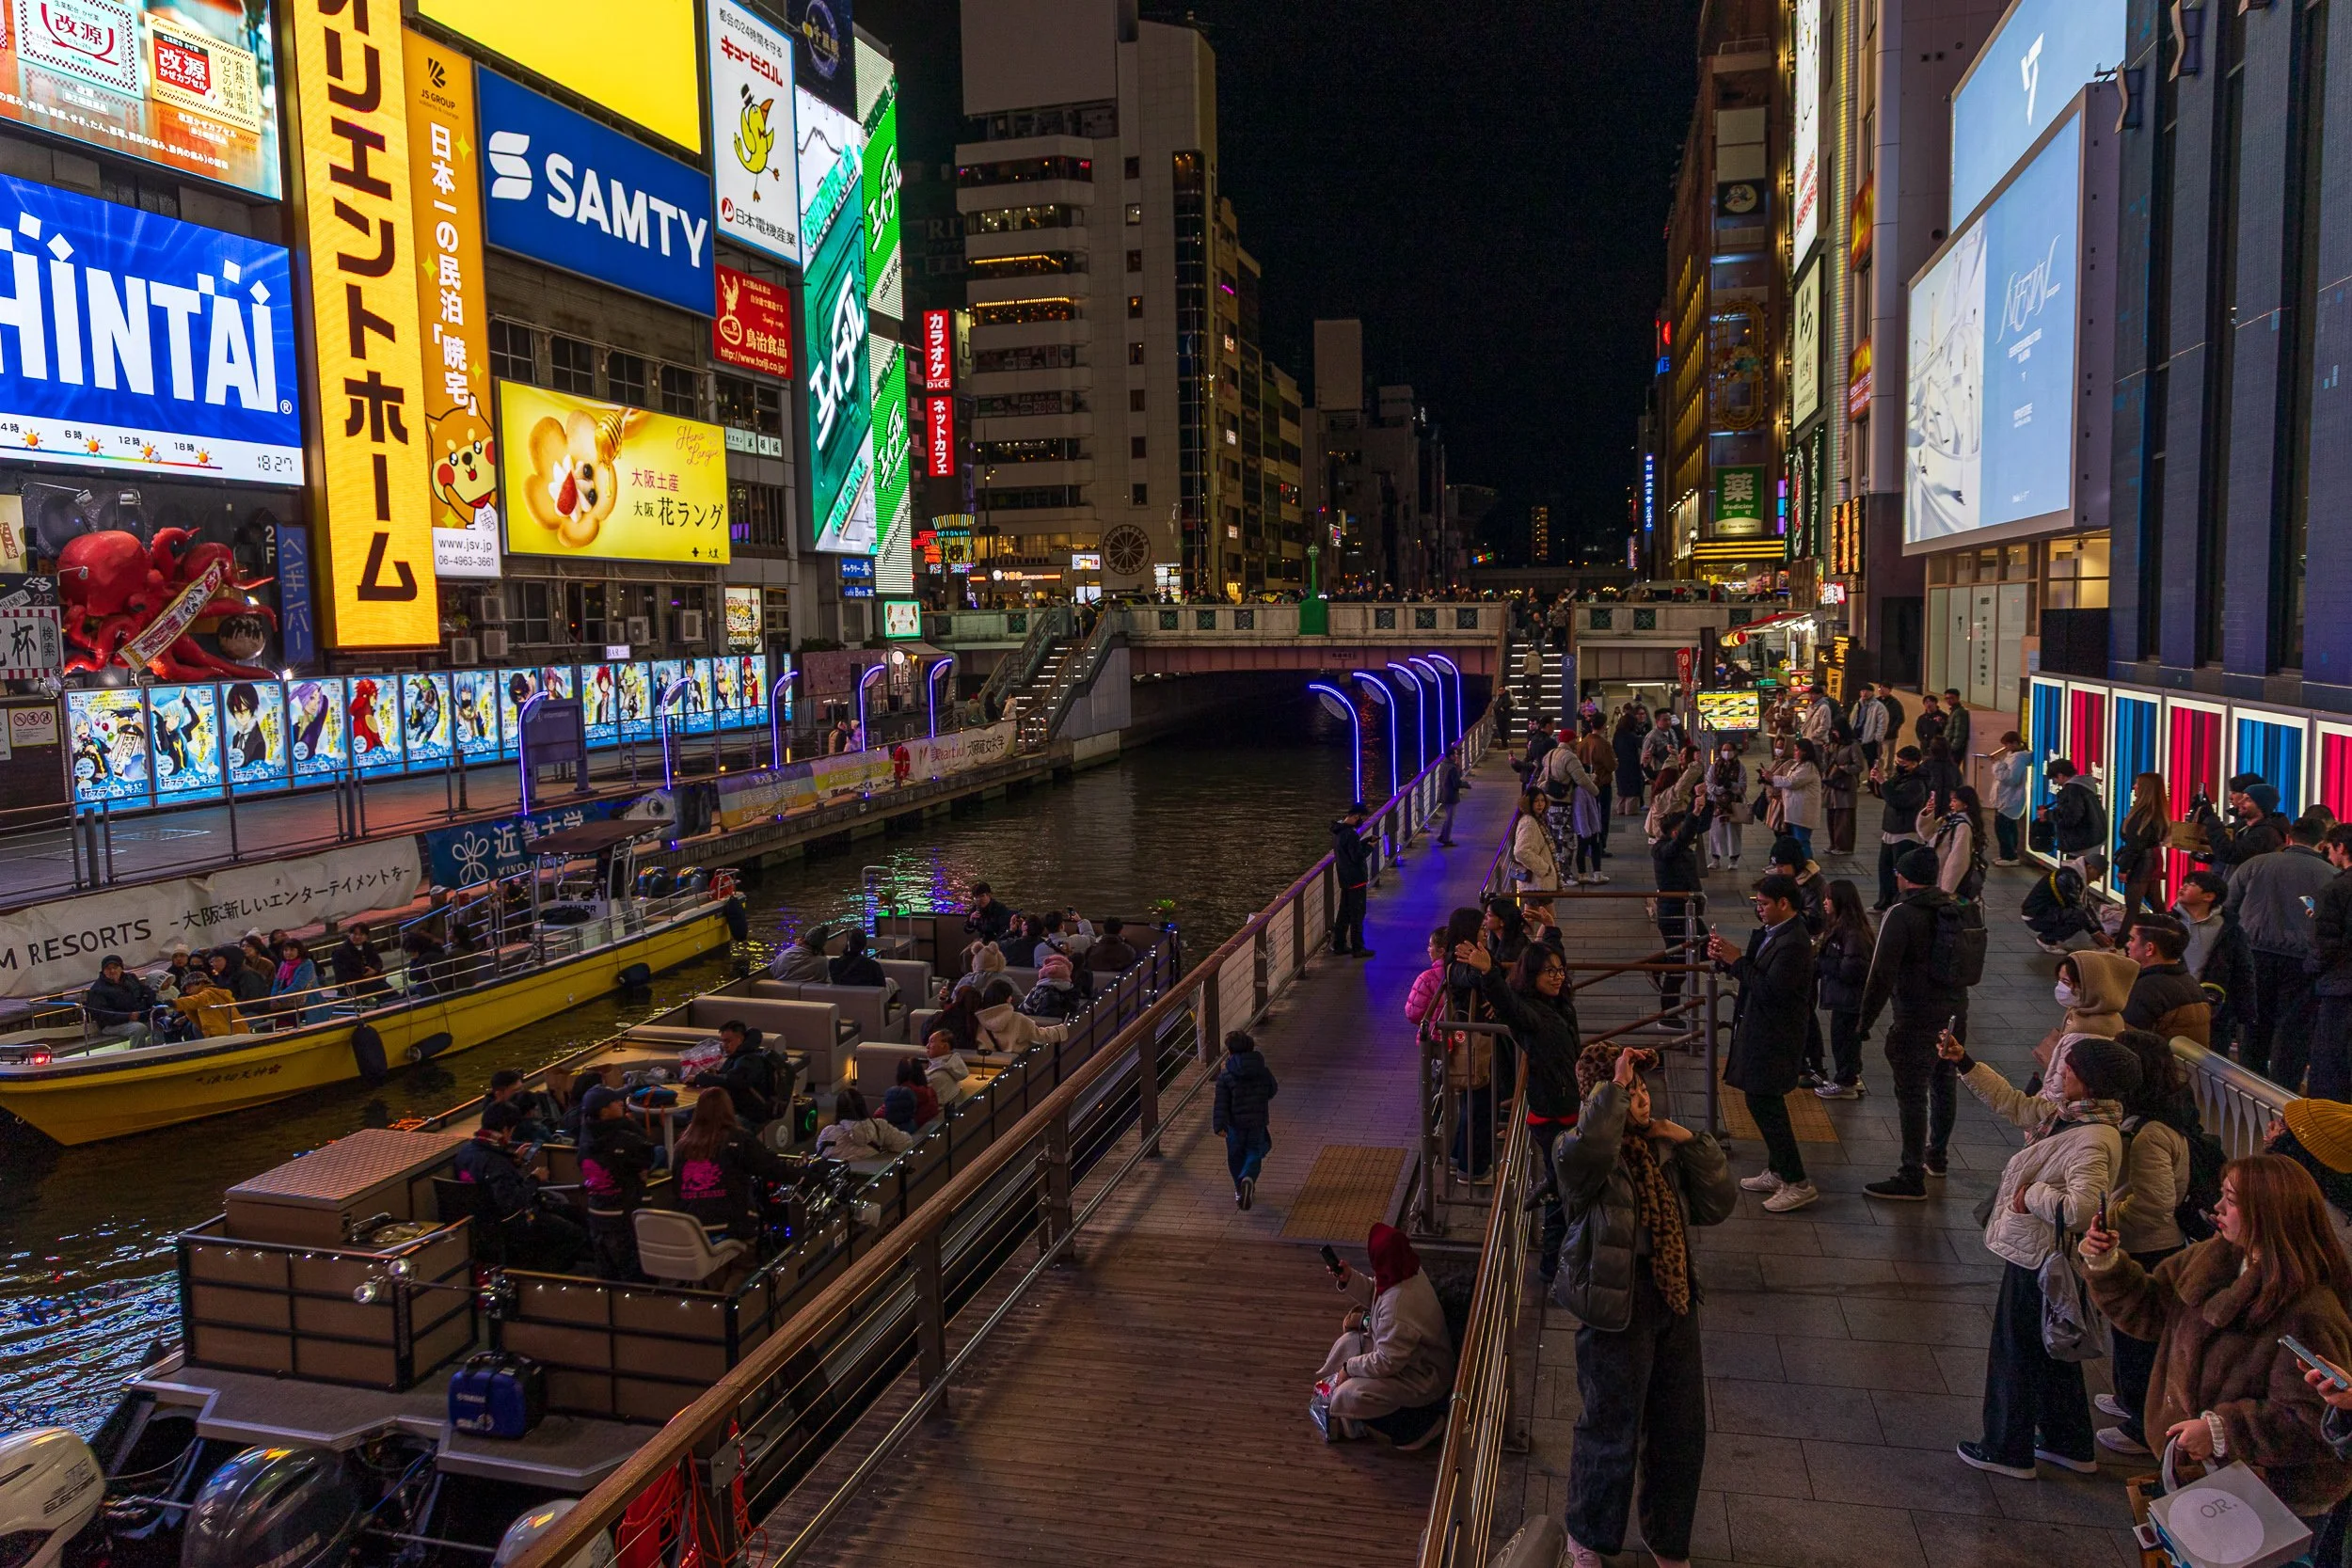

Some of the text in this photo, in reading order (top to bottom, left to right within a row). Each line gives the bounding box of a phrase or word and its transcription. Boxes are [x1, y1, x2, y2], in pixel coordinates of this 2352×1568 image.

[55, 12, 103, 45] 改源
[157, 46, 207, 82] 改源
[721, 35, 783, 87] キュービクル
[160, 67, 208, 91] かぜカプセル
[421, 89, 430, 100] JS
[431, 92, 456, 110] GROUP
[546, 153, 707, 268] SAMTY
[930, 313, 946, 378] カラオケ
[65, 430, 83, 440] 6時
[119, 436, 140, 447] 12時
[174, 441, 195, 452] 18時
[933, 400, 948, 475] ネットカフェ
[631, 467, 679, 492] 大阪土産
[1724, 472, 1754, 502] 薬
[658, 497, 724, 531] 花ラング
[264, 525, 276, 565] 2F
[437, 555, 494, 566] 06-4963-3661
[438, 538, 493, 553] www.jsv.jp
[33, 594, 55, 607] 2F
[41, 626, 56, 658] 検索
[30, 918, 151, 966] RESORTS
